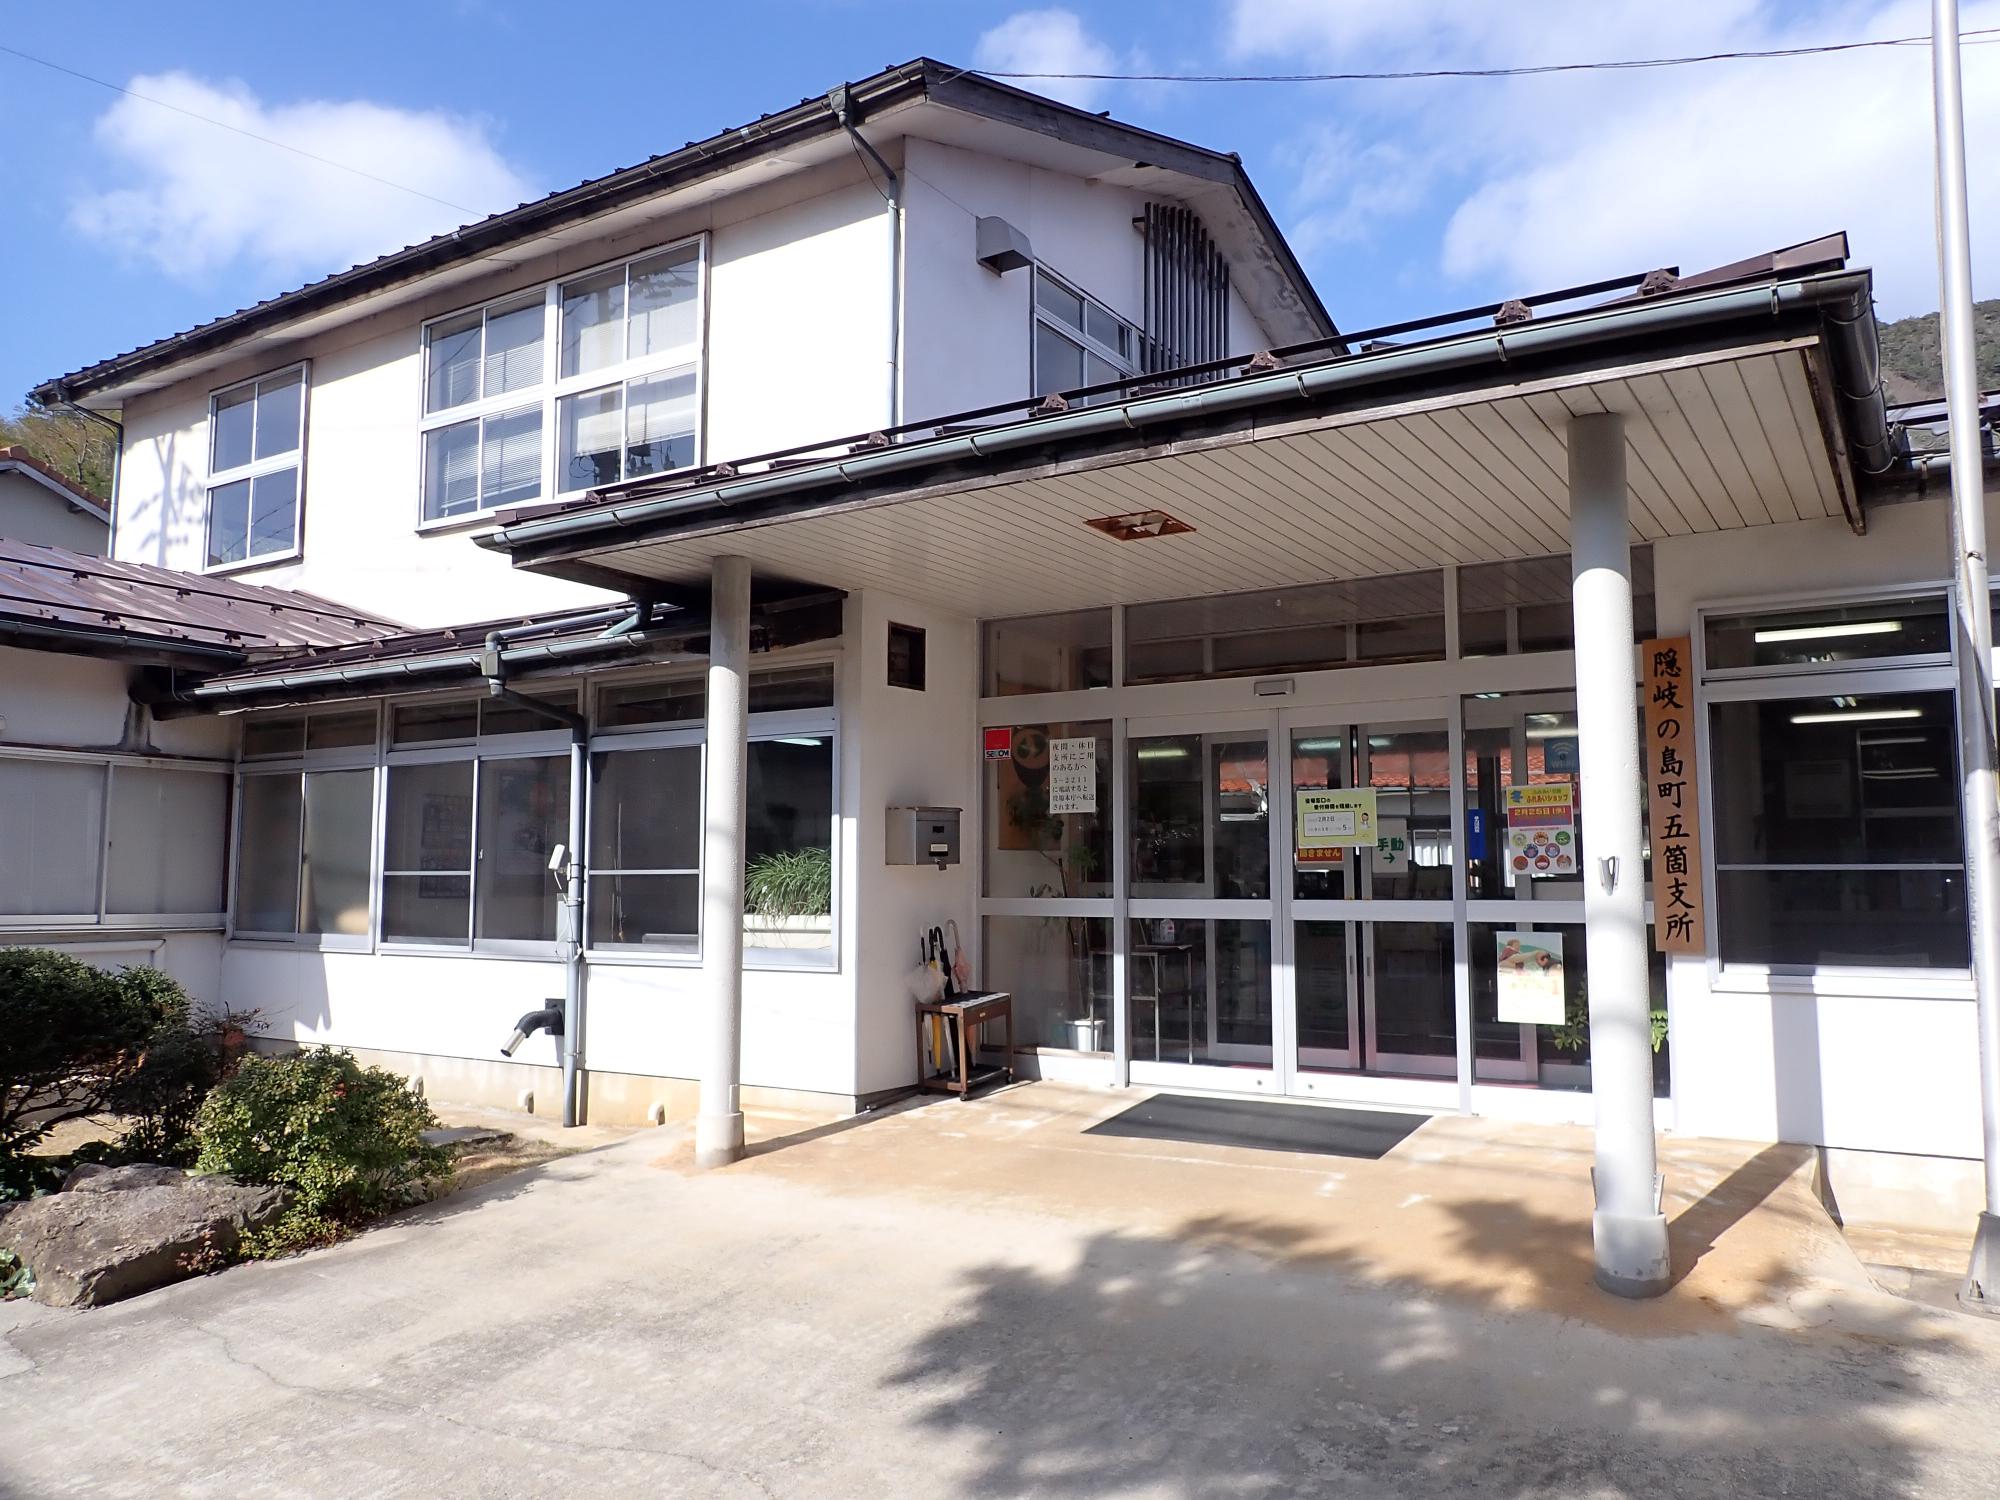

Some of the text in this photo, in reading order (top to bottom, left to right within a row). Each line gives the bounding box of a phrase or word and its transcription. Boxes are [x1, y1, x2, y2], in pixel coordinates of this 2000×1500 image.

[1052, 741, 1094, 751] 夜間・休日
[1053, 752, 1094, 762] 支所にご用
[1052, 763, 1088, 771] のある方へ
[1652, 647, 1696, 944] 隠岐の島町五箇支所
[1377, 837, 1404, 852] 手動
